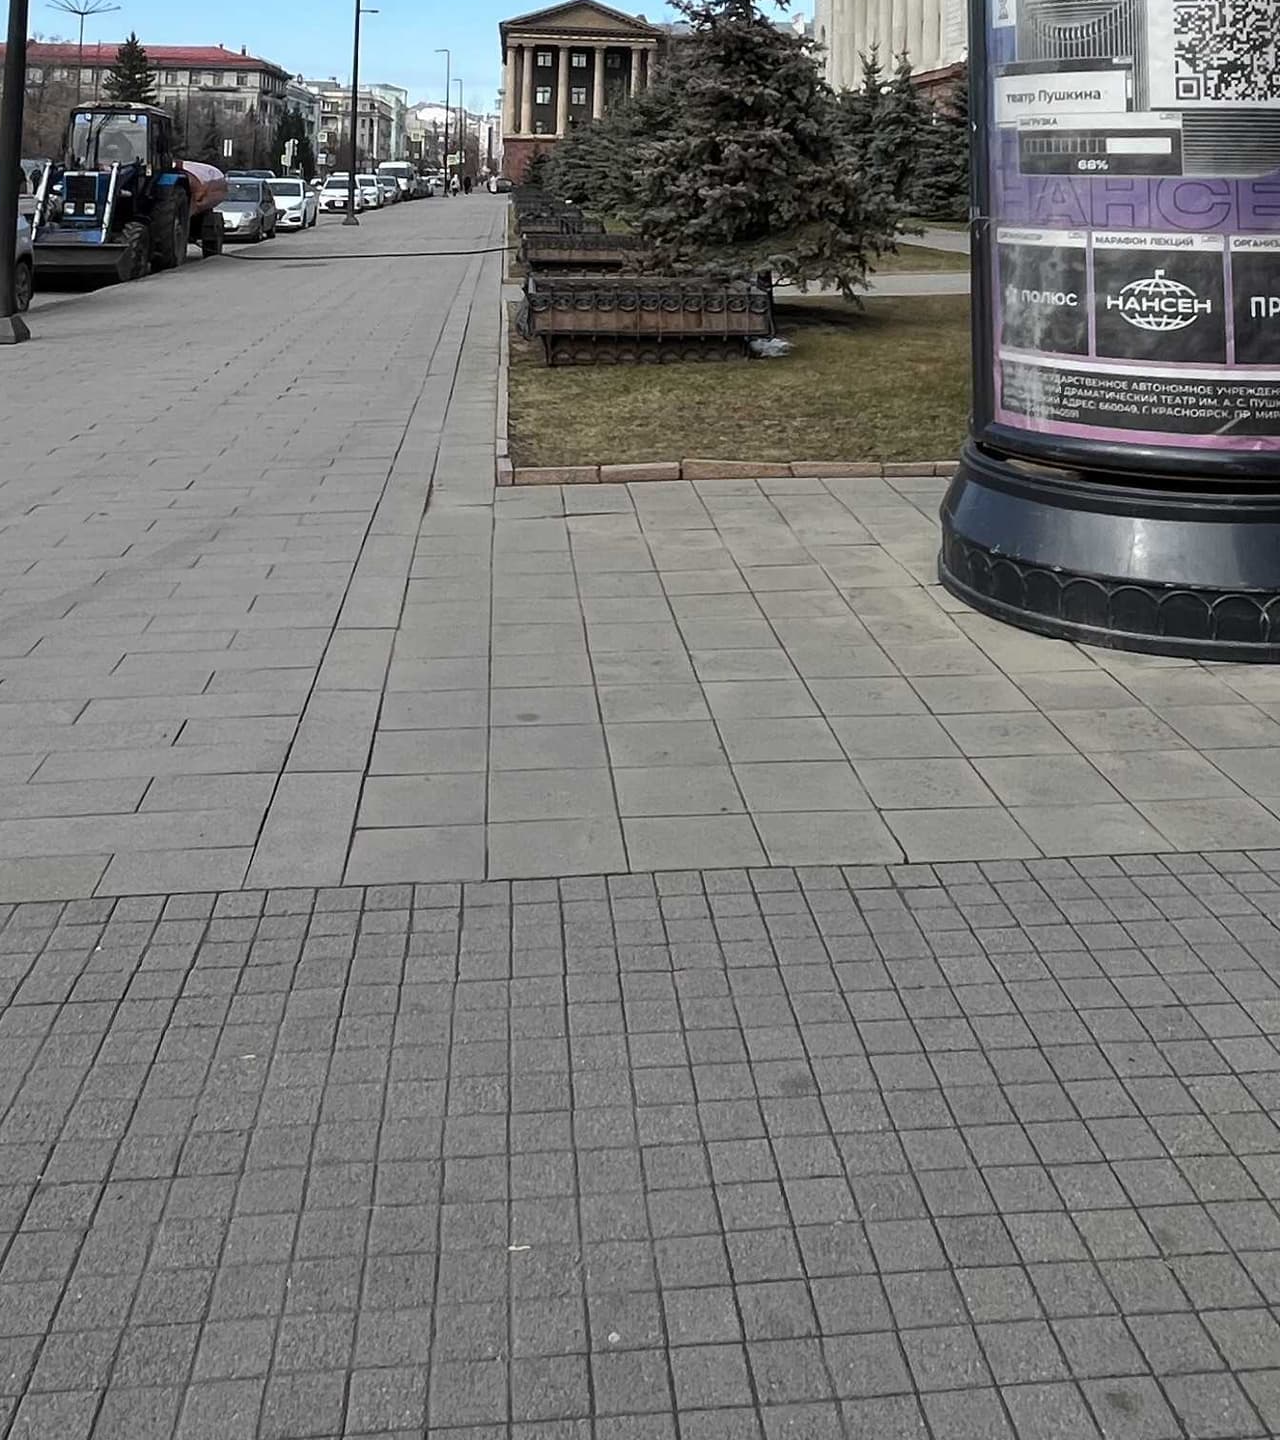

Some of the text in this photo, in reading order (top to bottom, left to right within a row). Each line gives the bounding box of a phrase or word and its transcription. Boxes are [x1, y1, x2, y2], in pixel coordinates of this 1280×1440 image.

[1006, 89, 1101, 104] театр Пушкина
[1095, 237, 1194, 247] МАРАФОН ЛЕКЦИЙ
[1022, 290, 1078, 306] ПОЛЮС
[1106, 295, 1211, 314] НАНСЕН
[1131, 381, 1213, 395] АВТОНОМНОЕ
[1064, 387, 1158, 403] ДРАМАТИЧЕСКИЙ
[1161, 395, 1196, 406] ТЕАТР
